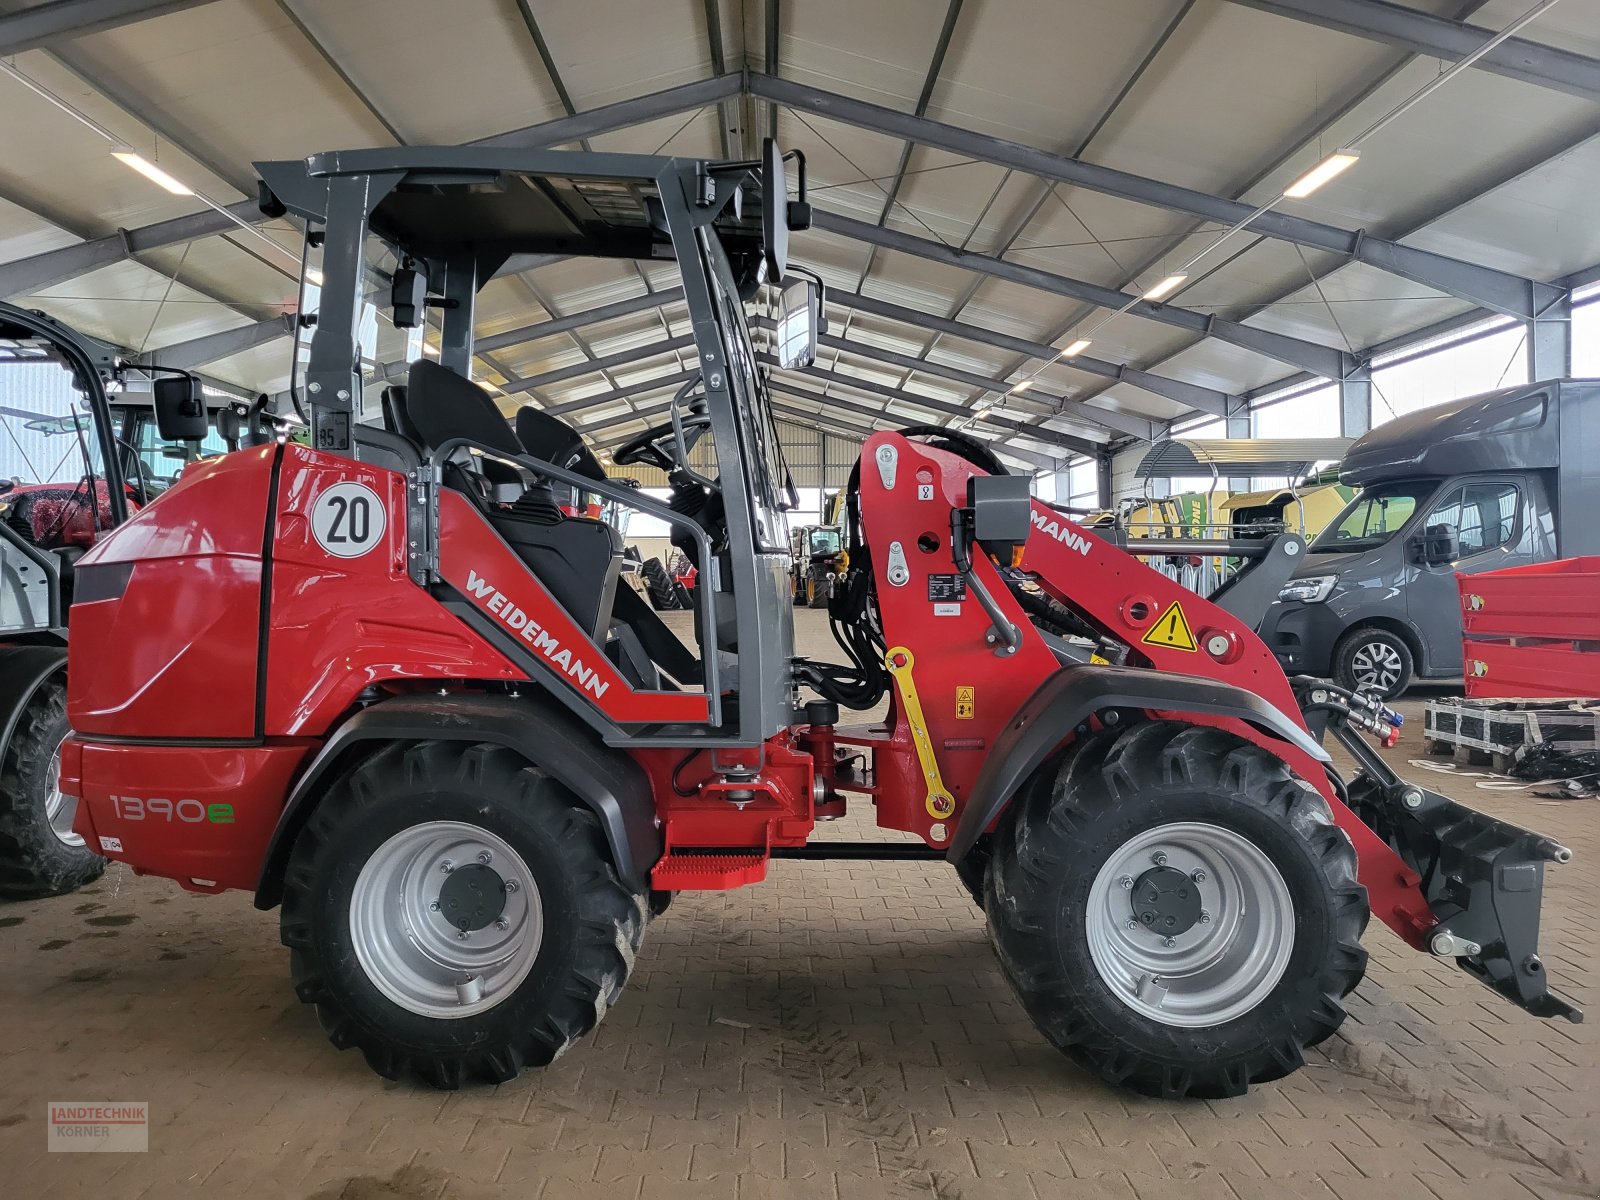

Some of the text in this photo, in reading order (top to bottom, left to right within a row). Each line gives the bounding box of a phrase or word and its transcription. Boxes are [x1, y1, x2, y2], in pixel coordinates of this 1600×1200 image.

[327, 495, 369, 543] 20
[1030, 509, 1093, 556] MANN
[465, 569, 610, 699] WEIDEMANN
[109, 795, 235, 823] 1390e
